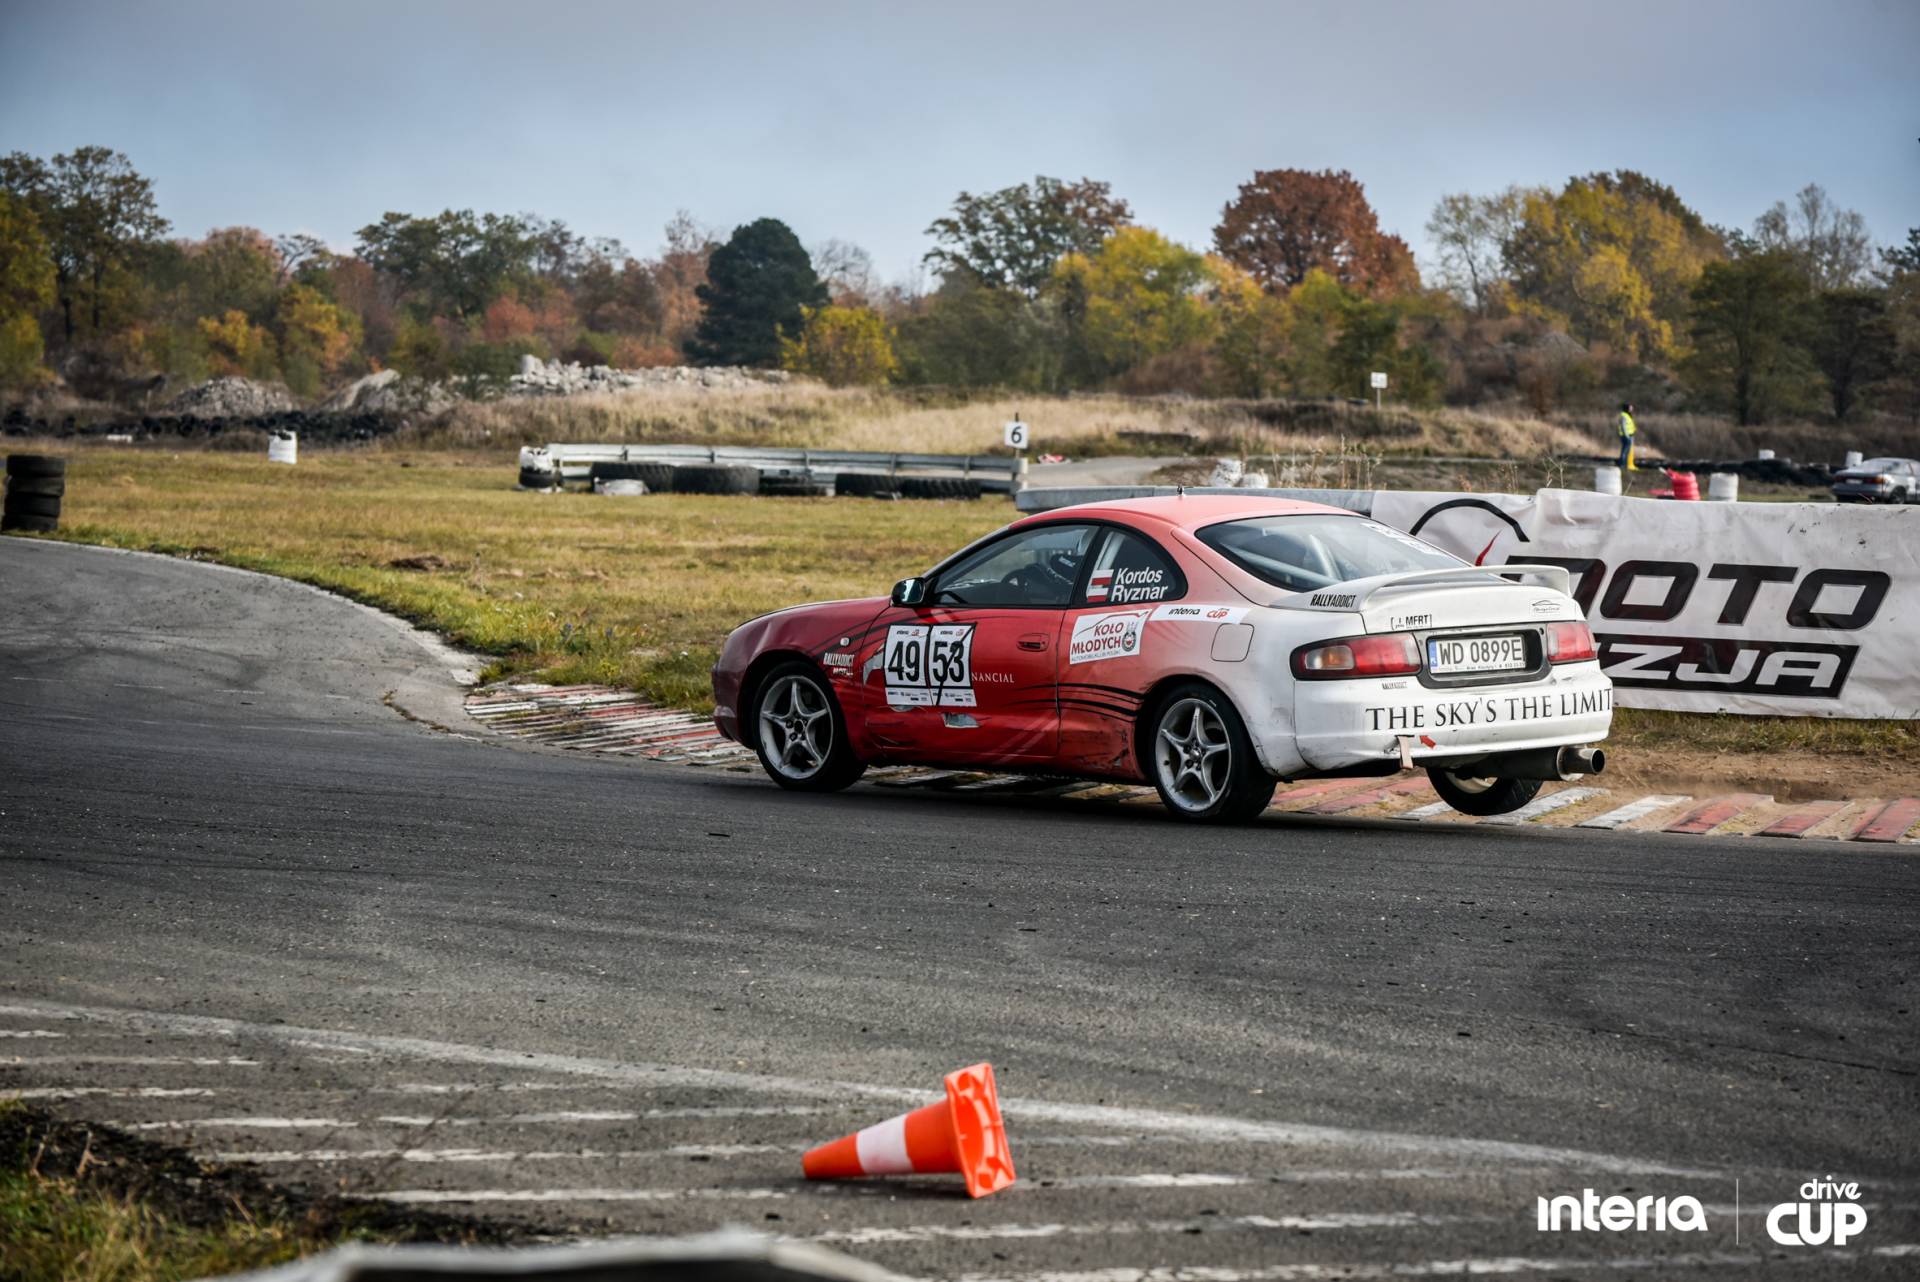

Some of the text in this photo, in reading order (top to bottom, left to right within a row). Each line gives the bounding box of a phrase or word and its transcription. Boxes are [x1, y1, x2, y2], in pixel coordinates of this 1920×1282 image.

[1011, 426, 1022, 444] 6
[1115, 567, 1163, 585] Kordos
[1111, 584, 1169, 603] Ryznar
[1094, 622, 1125, 637] KOŁO
[1071, 635, 1122, 656] MŁODYCH
[1439, 639, 1522, 665] WD 0899E
[888, 641, 965, 682] 49 53
[1596, 642, 1843, 689] ZJA
[1366, 687, 1612, 731] THE SKY'S THE LIMIT
